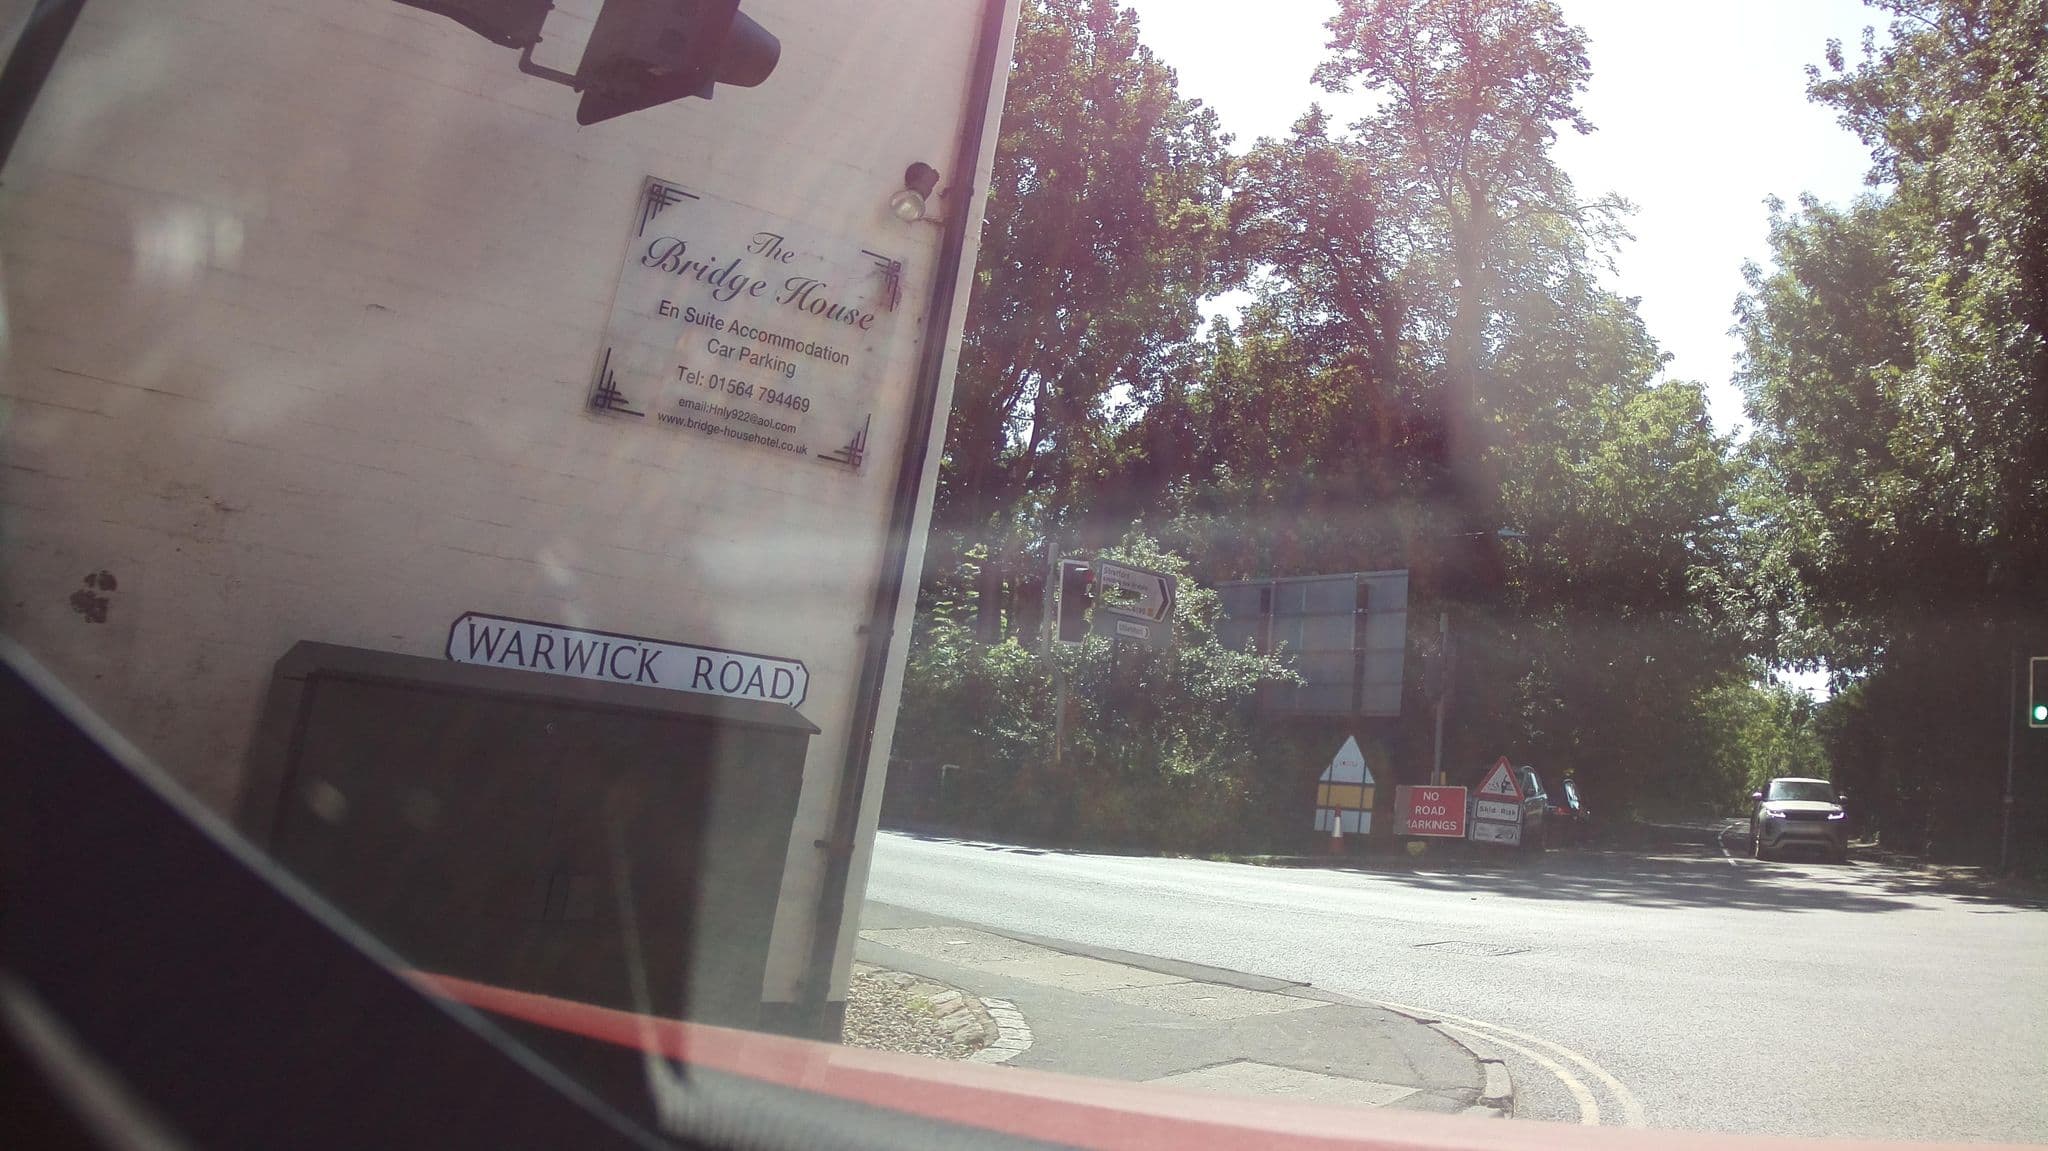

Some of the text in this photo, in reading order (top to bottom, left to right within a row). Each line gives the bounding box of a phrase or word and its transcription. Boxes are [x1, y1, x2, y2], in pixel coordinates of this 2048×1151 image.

[747, 230, 795, 265] The
[641, 235, 876, 332] Bridge House
[658, 299, 851, 366] En Suite Accommodation
[706, 338, 798, 379] Car Parking
[676, 365, 812, 413] Tel: 01564 794469
[657, 411, 809, 456] www.bridge-househotel.co.uk
[467, 623, 796, 702] WARWICK ROAD
[1414, 805, 1446, 816] ROAD
[1423, 791, 1440, 801] NO
